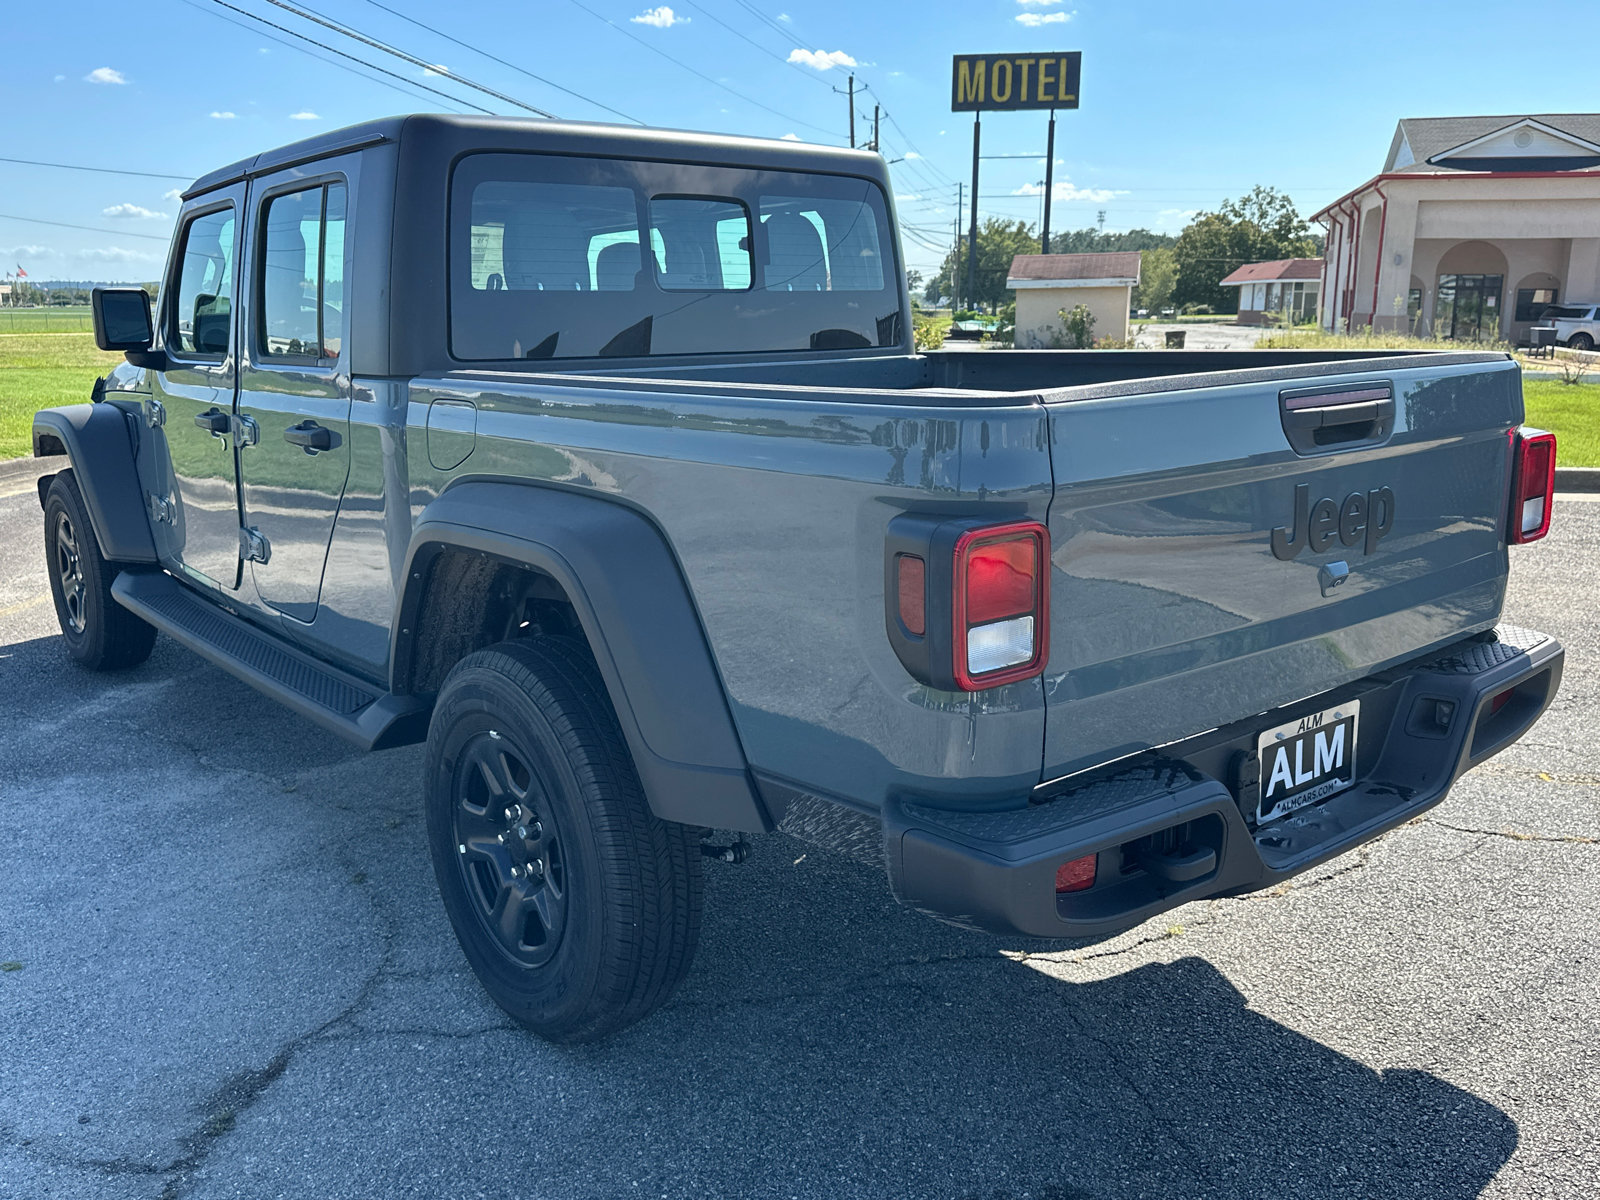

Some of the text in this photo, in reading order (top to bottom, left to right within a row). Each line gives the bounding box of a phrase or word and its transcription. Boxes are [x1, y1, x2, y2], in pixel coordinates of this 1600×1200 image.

[957, 58, 1076, 103] MOTEL
[1270, 483, 1395, 561] Jeep
[1297, 712, 1323, 734] ALM
[1265, 723, 1346, 798] ALM
[1281, 782, 1334, 812] ALMCARS.COM
